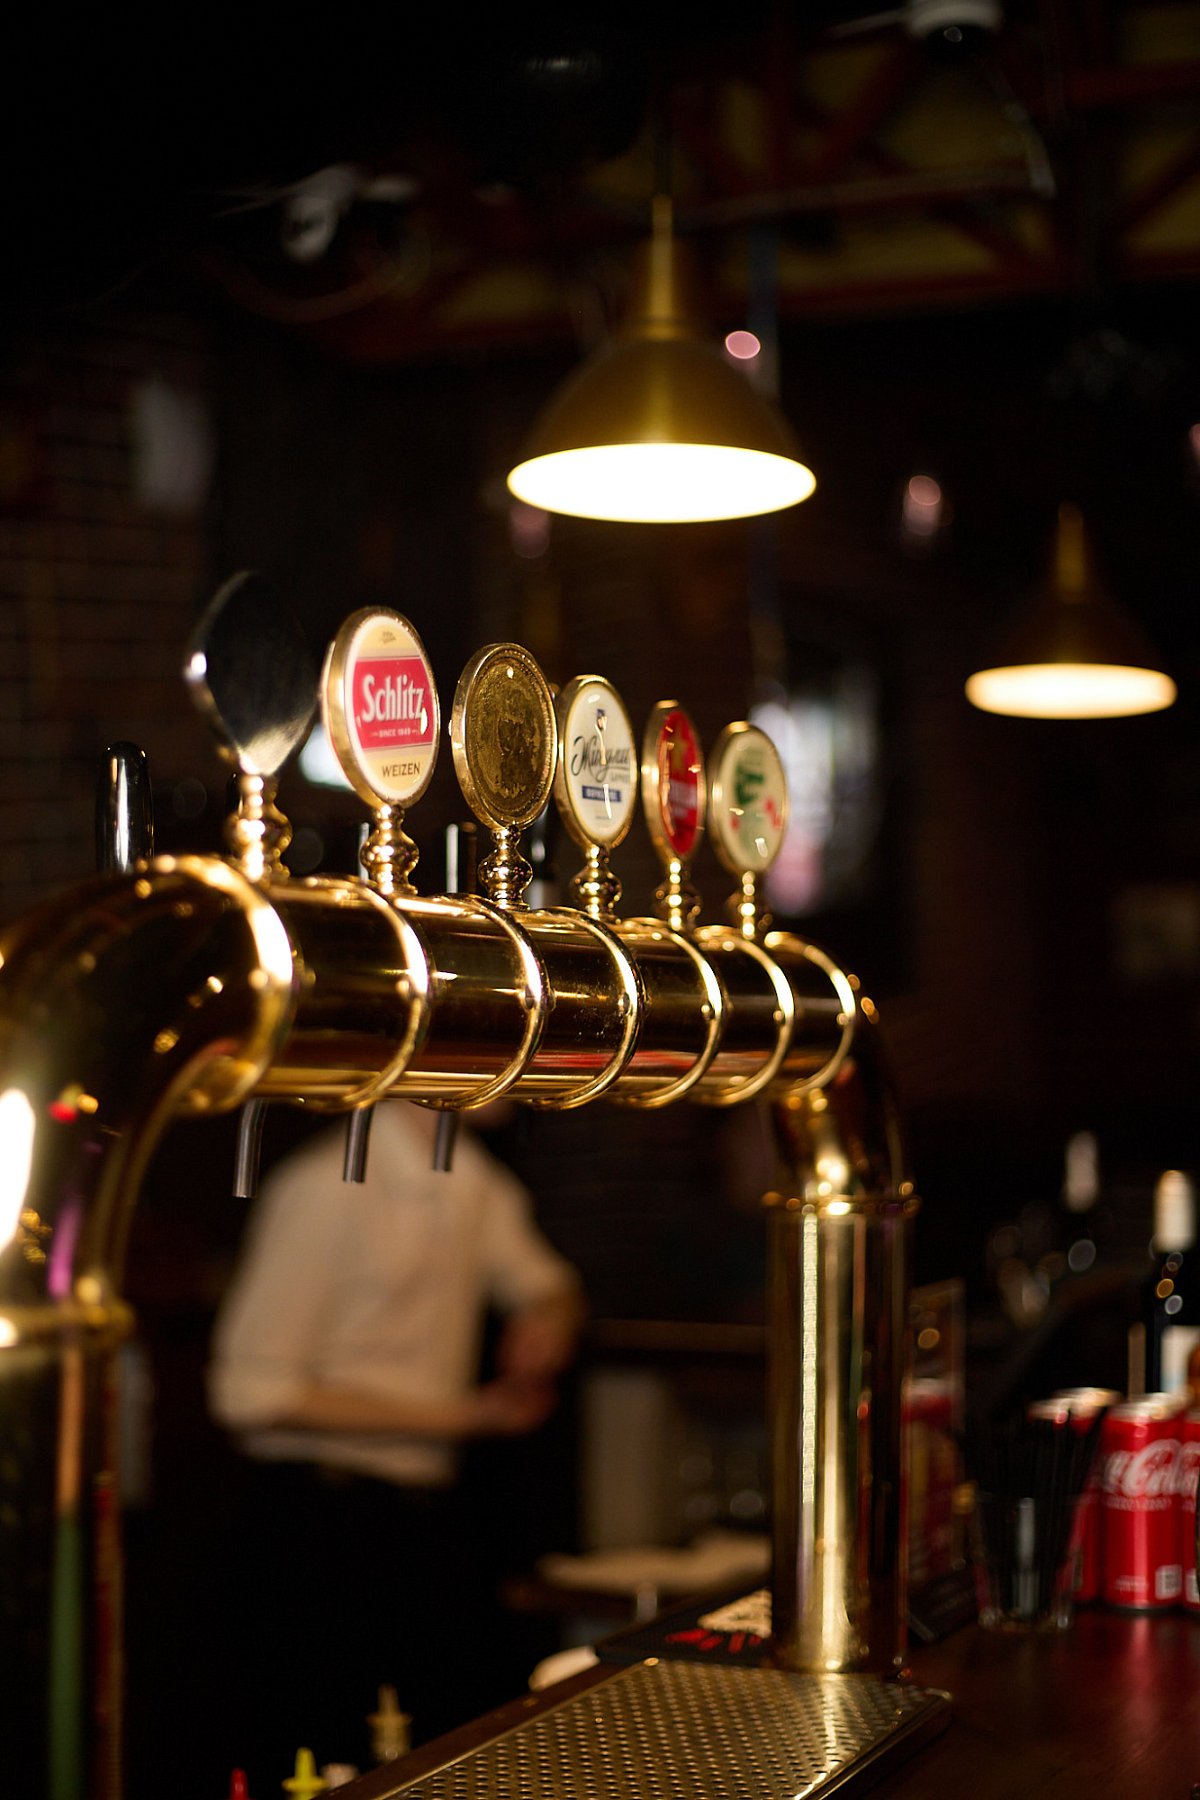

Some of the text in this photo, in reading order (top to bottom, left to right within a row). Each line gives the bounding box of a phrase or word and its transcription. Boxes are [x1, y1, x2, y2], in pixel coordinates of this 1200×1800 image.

[362, 673, 425, 723] Schlitz
[379, 729, 397, 738] SINCE
[382, 761, 421, 778] WEIZEN
